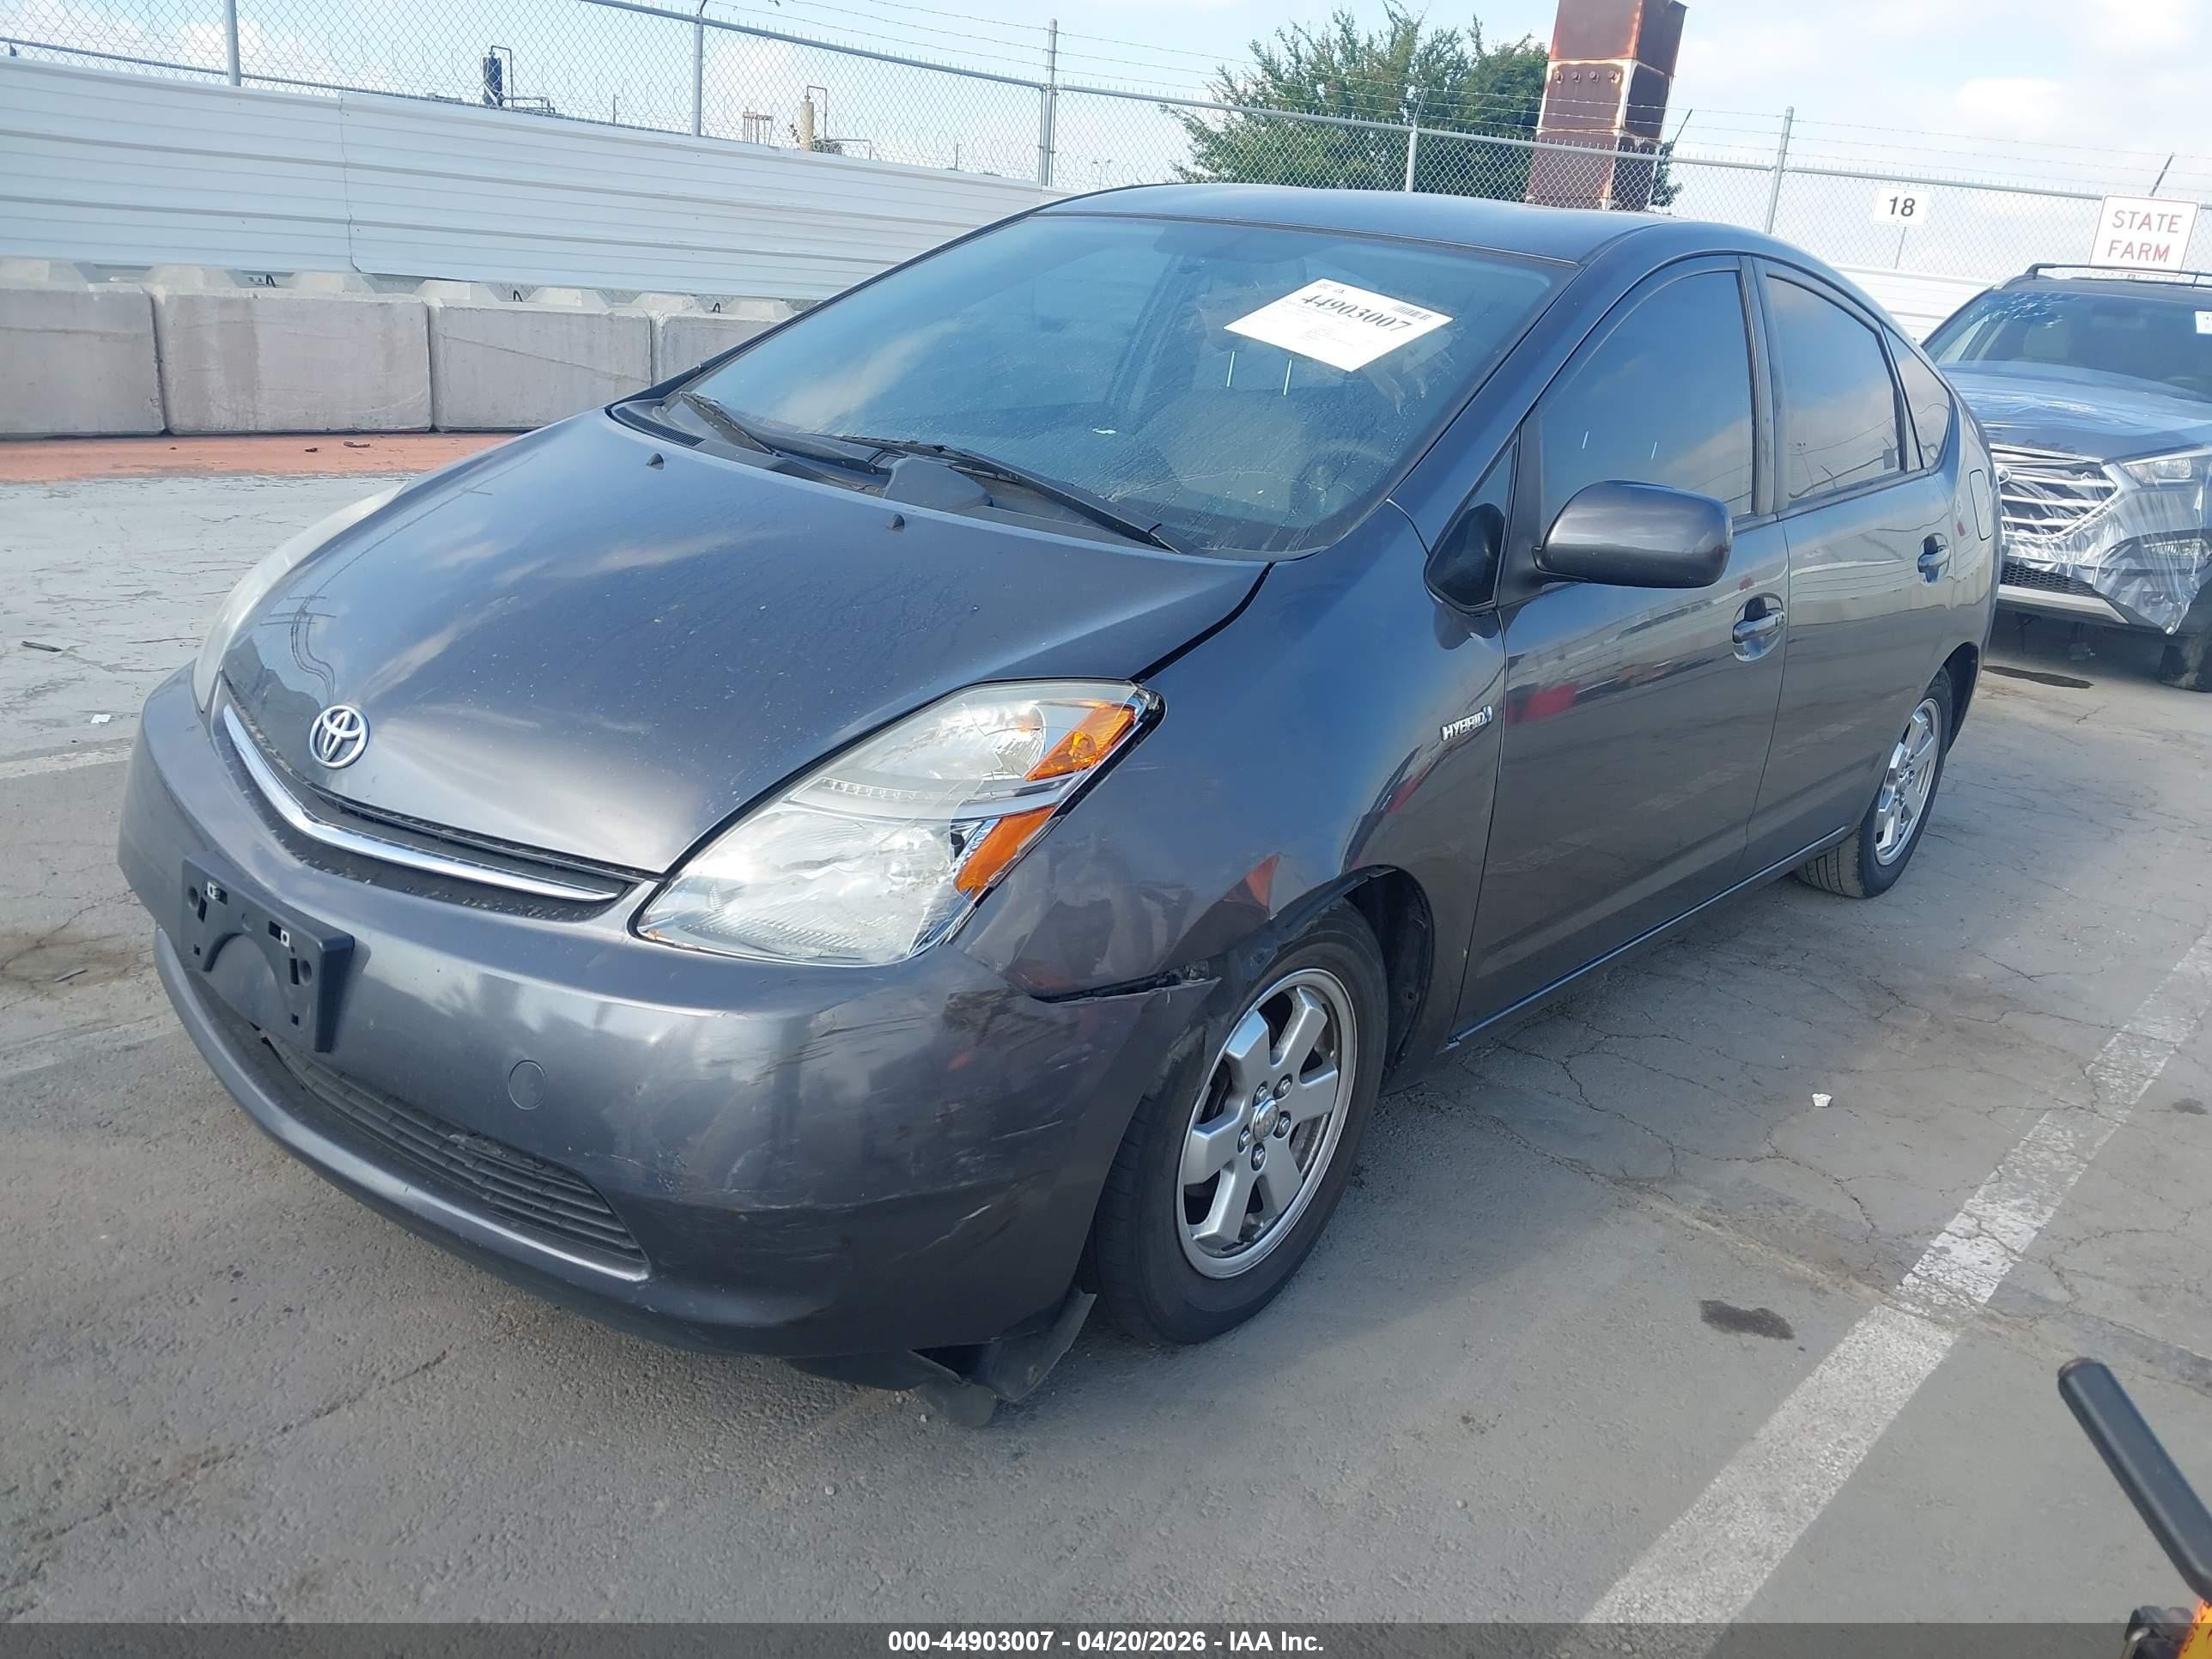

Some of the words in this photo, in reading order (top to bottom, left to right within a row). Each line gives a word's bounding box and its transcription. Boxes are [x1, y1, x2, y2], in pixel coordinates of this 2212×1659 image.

[1888, 196, 1916, 217] 18
[2112, 209, 2183, 234] STATE
[2106, 240, 2171, 264] FARM
[1301, 295, 1413, 332] 44903007
[1442, 712, 1486, 741] HYBRID
